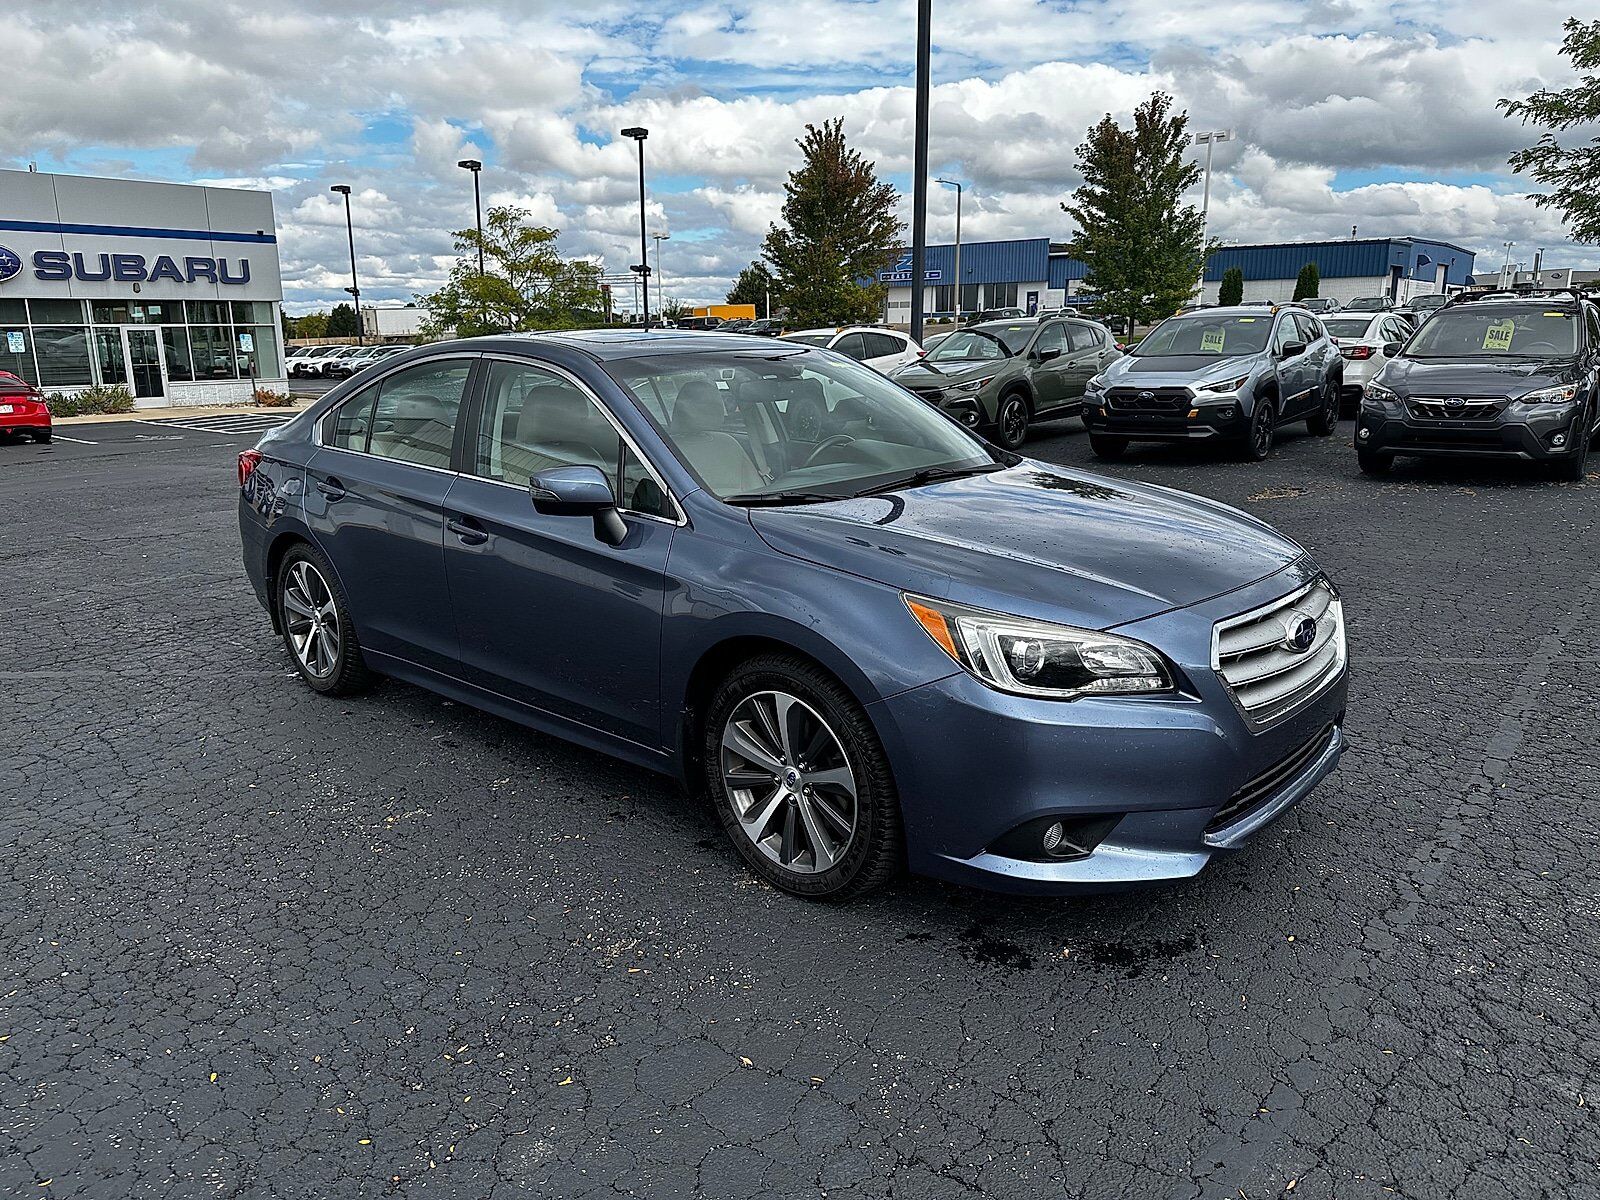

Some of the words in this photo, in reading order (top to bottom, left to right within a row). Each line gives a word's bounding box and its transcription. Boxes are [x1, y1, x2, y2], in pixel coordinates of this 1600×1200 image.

[33, 251, 251, 284] SUBARU
[1204, 334, 1223, 345] SALE
[1488, 329, 1511, 341] SALE
